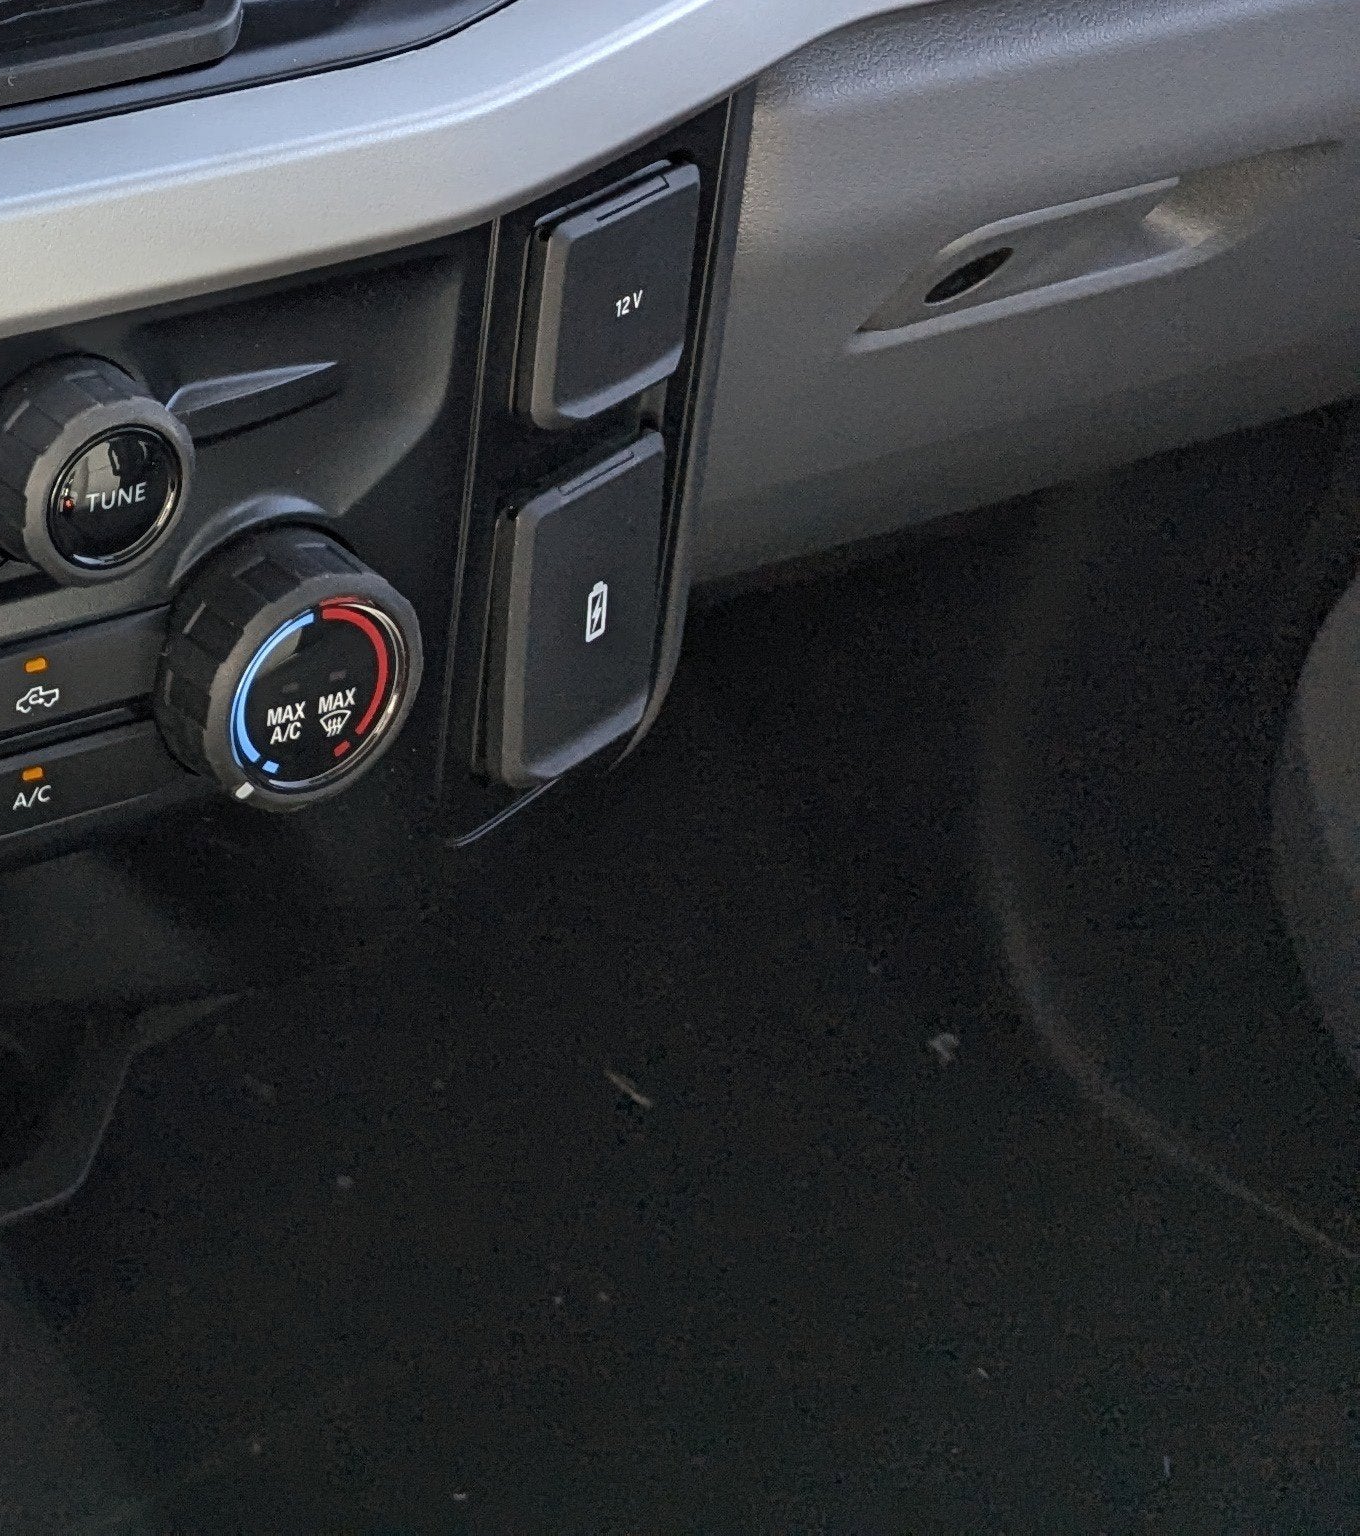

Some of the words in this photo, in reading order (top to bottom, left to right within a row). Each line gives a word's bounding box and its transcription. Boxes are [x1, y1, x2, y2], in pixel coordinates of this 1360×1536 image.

[86, 482, 147, 512] TUNE
[266, 701, 306, 727] MAX
[318, 687, 357, 714] MAX
[270, 721, 302, 744] A/C
[11, 783, 53, 812] A/C
